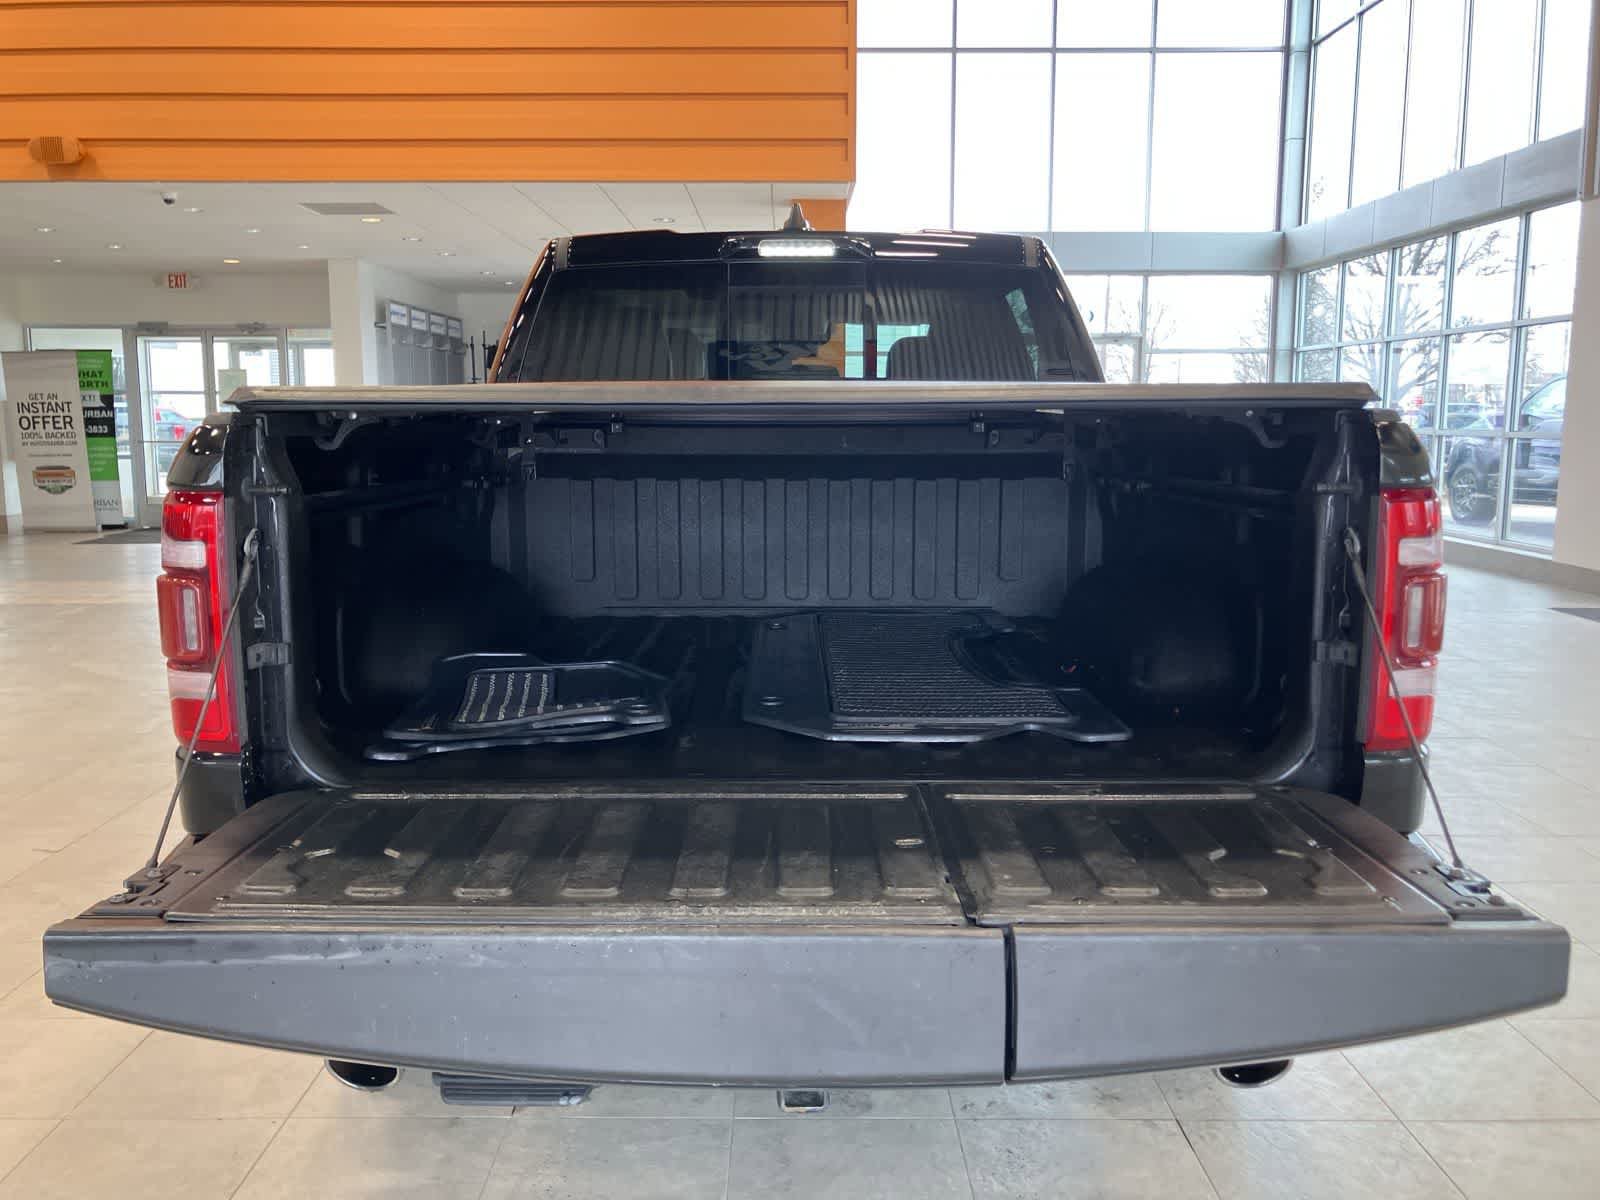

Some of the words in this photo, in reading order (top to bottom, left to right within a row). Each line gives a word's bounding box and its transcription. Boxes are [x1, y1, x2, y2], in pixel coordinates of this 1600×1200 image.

[168, 272, 187, 288] EXIT
[79, 380, 108, 388] ORTH
[29, 392, 43, 400] GET
[47, 392, 57, 400] AN
[17, 401, 72, 414] INSTANT
[19, 415, 74, 431] OFFER
[21, 432, 43, 440] 100%
[45, 431, 77, 440] BACKED
